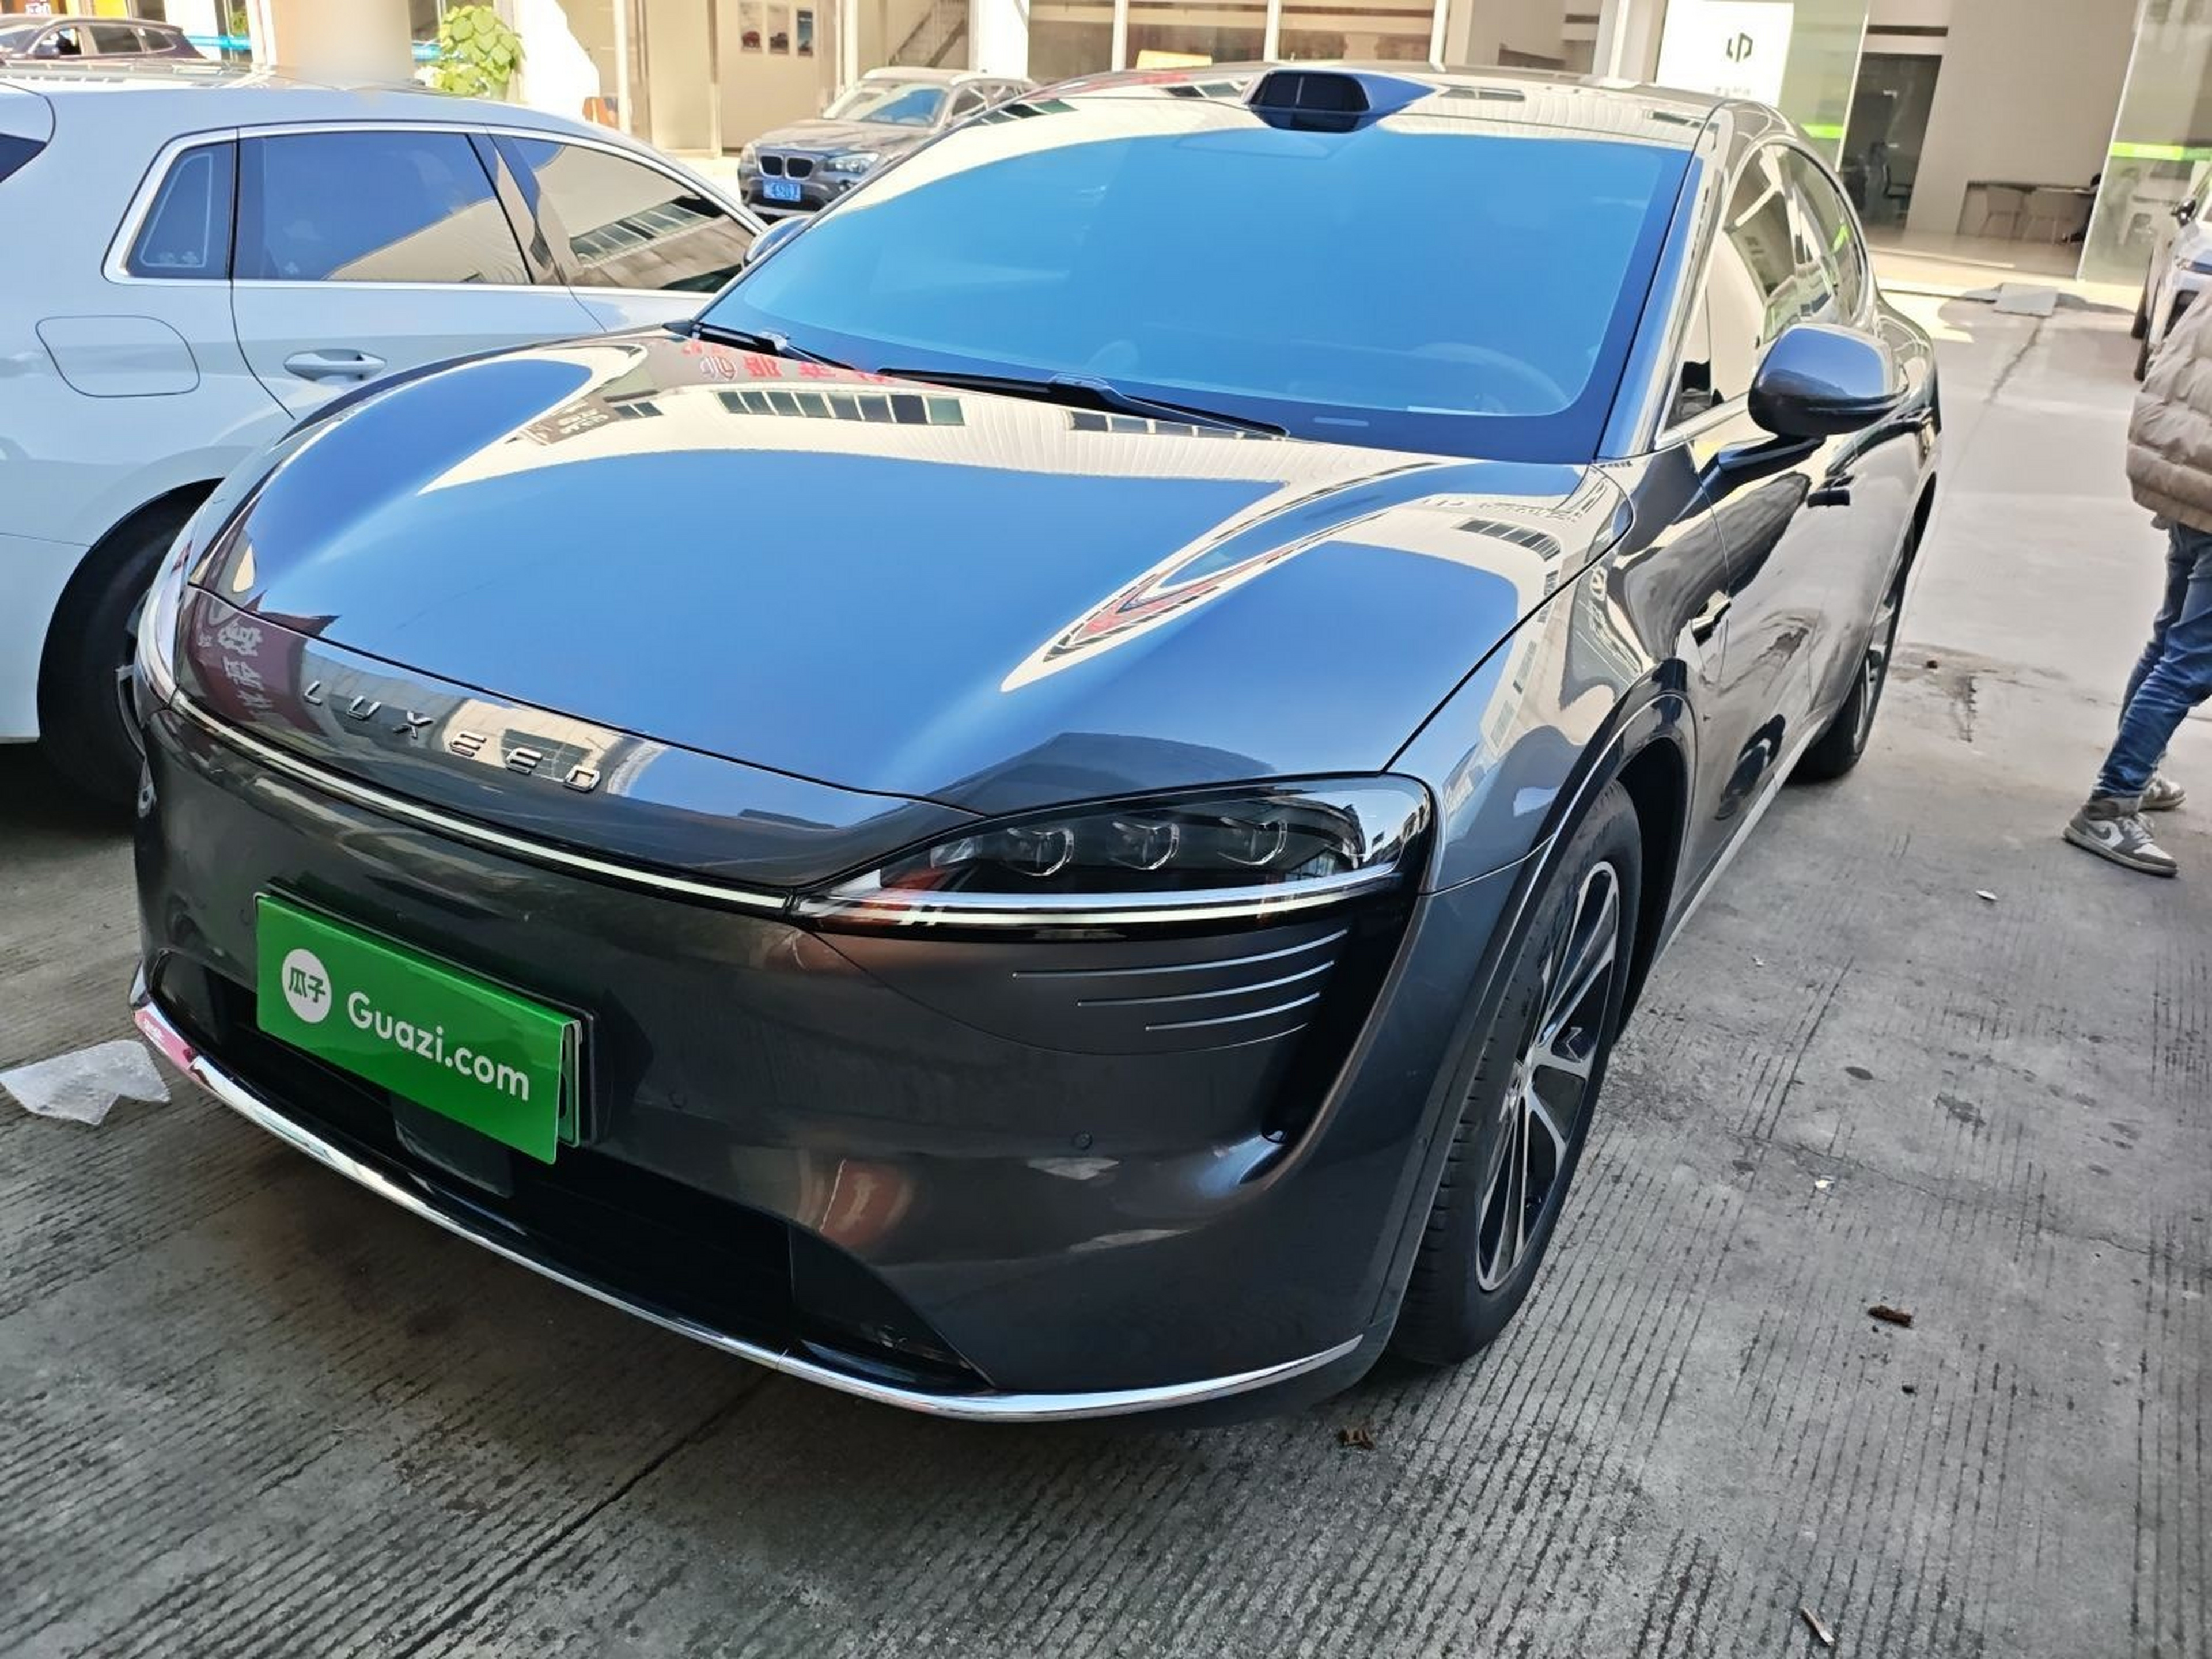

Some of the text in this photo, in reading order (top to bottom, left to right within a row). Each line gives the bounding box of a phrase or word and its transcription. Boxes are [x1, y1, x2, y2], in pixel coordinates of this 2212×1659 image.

[303, 680, 601, 793] LUXEED
[288, 967, 327, 1003] 瓜子
[347, 991, 529, 1101] Guazi.com
